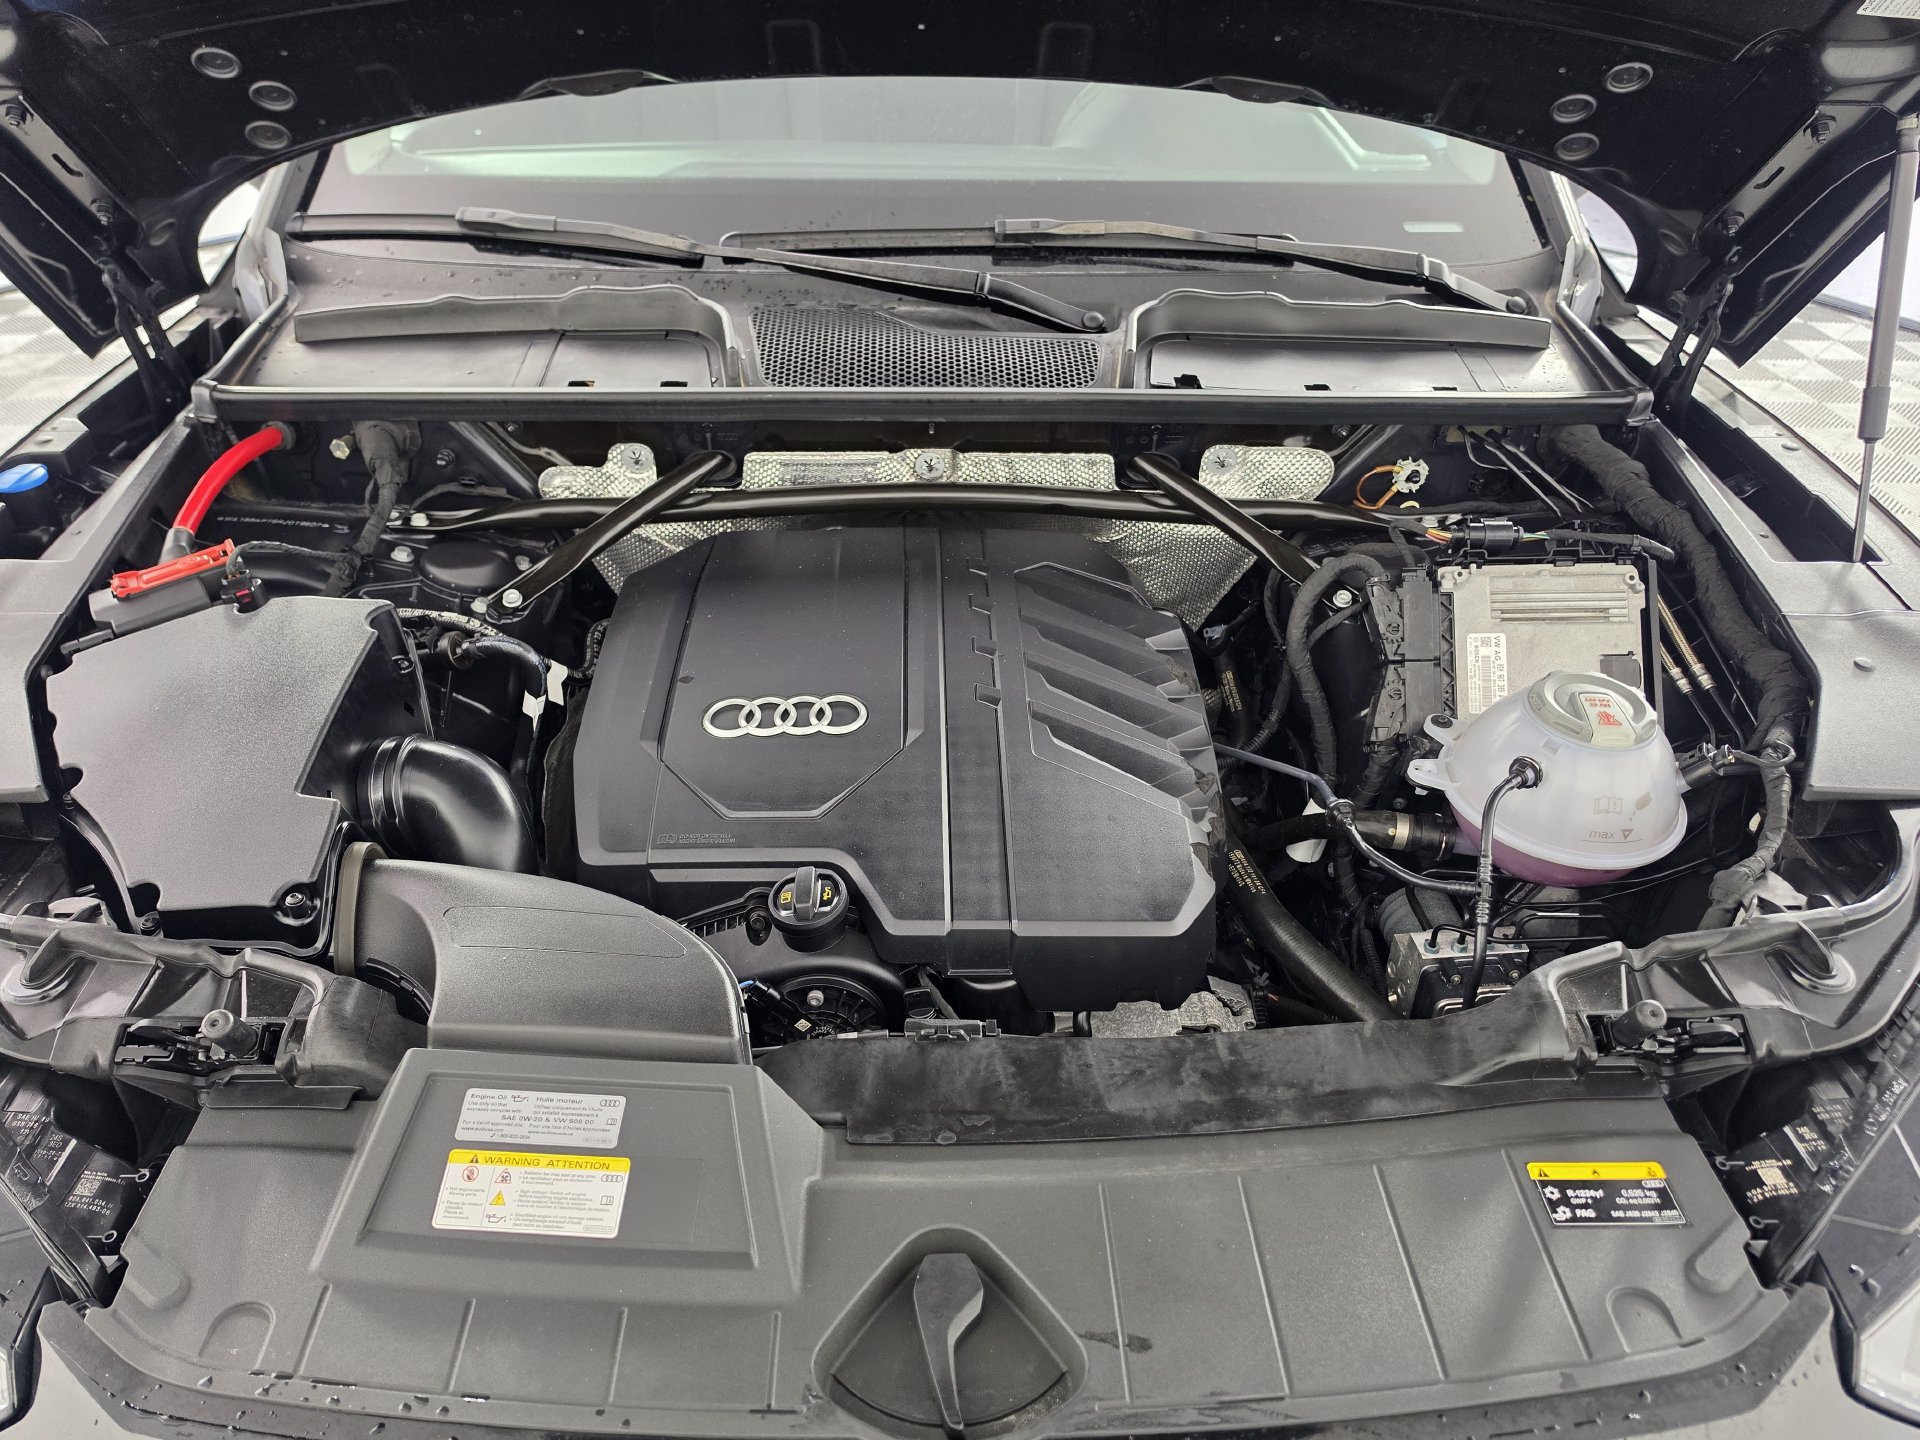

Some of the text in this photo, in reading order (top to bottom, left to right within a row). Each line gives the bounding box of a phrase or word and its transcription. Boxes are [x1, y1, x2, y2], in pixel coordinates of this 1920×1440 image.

[1590, 830, 1614, 839] max
[484, 1156, 610, 1170] WARNING ATTENTION
